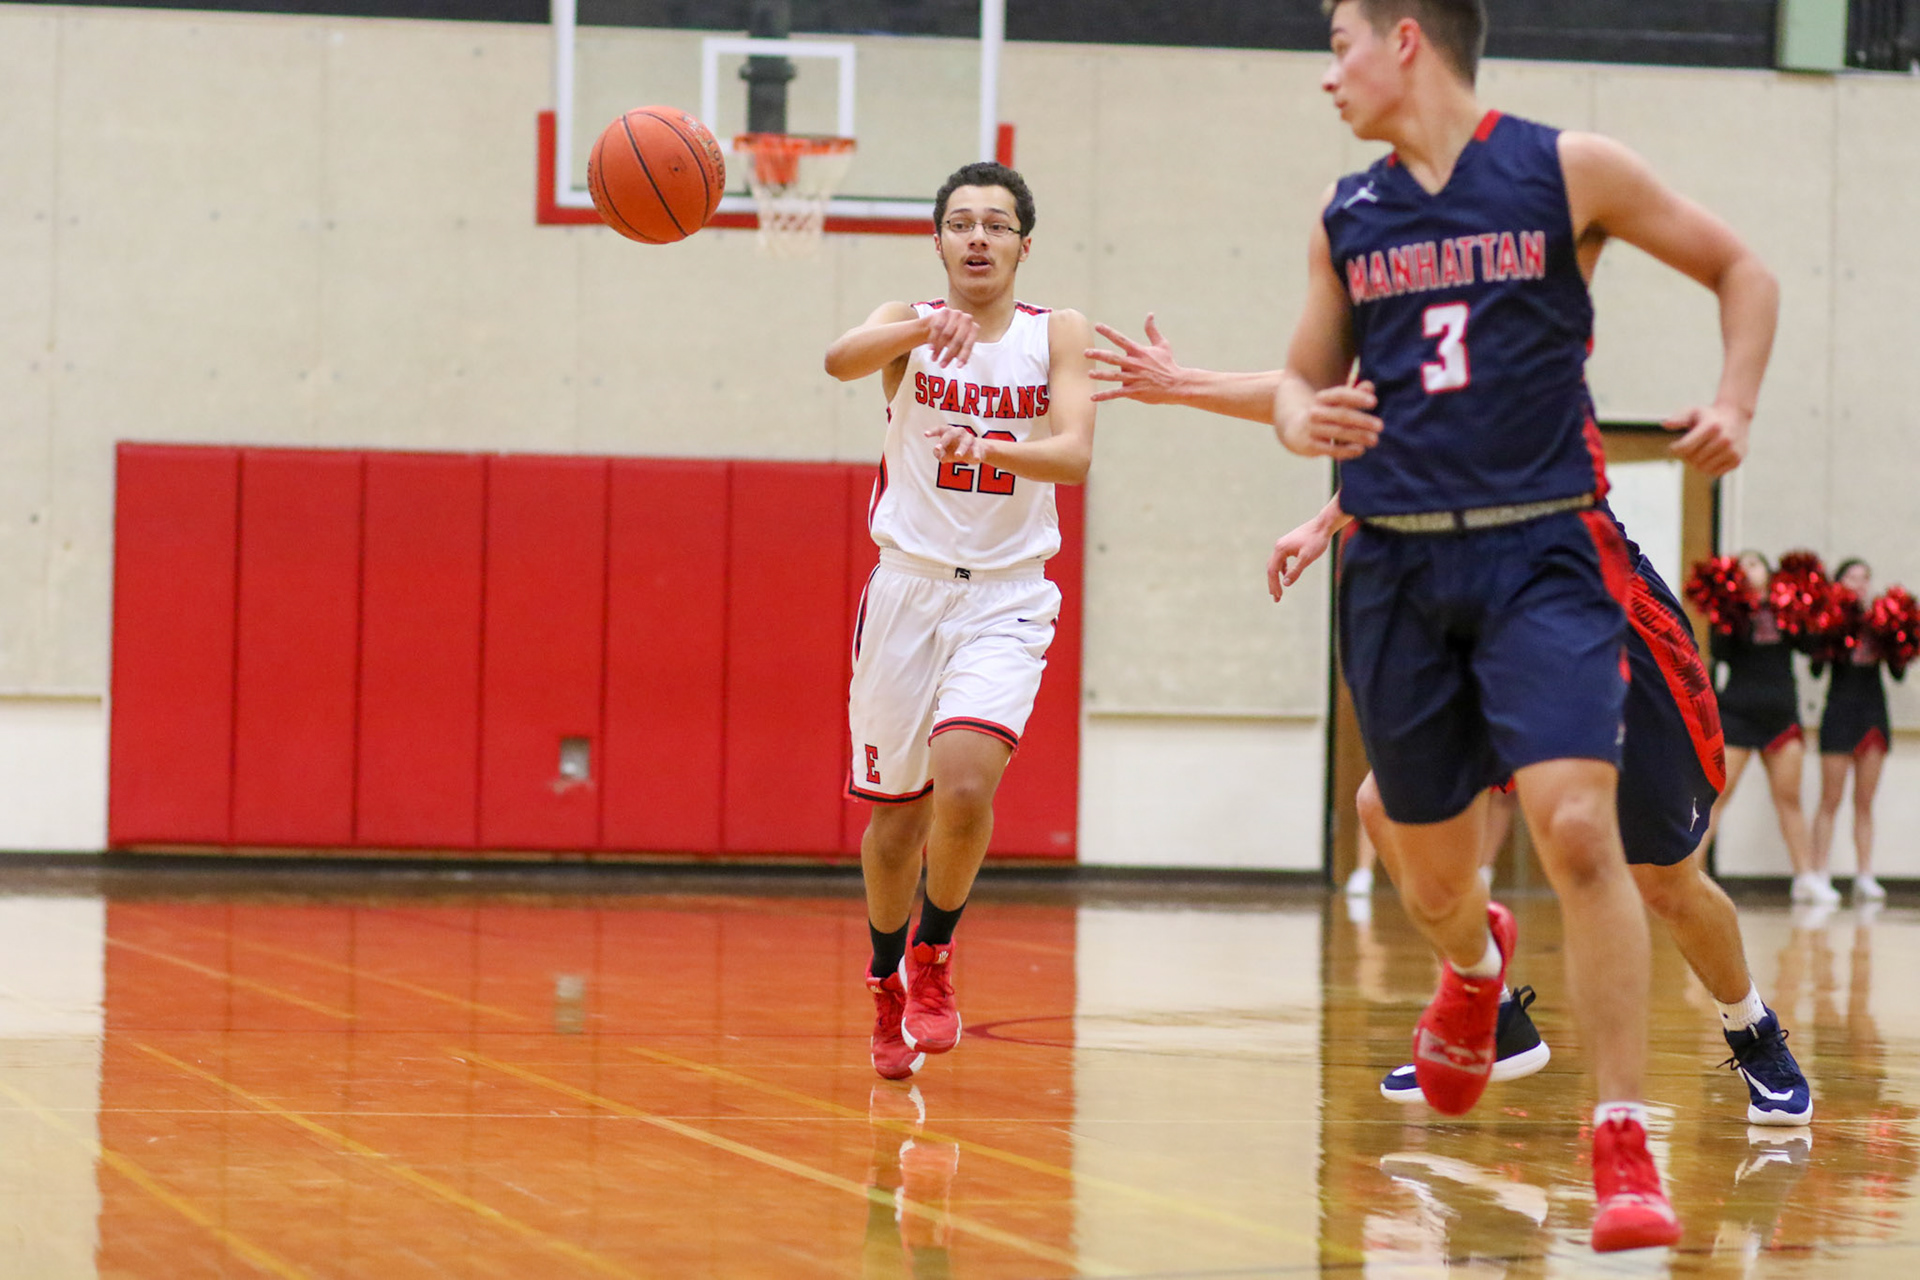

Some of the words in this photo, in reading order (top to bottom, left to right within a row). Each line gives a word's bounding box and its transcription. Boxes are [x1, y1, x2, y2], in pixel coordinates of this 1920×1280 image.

[1347, 231, 1545, 304] MANHATTAN
[1422, 302, 1470, 393] 3
[915, 371, 1050, 419] SPARTANS
[936, 423, 1017, 495] 22
[865, 743, 881, 785] E
